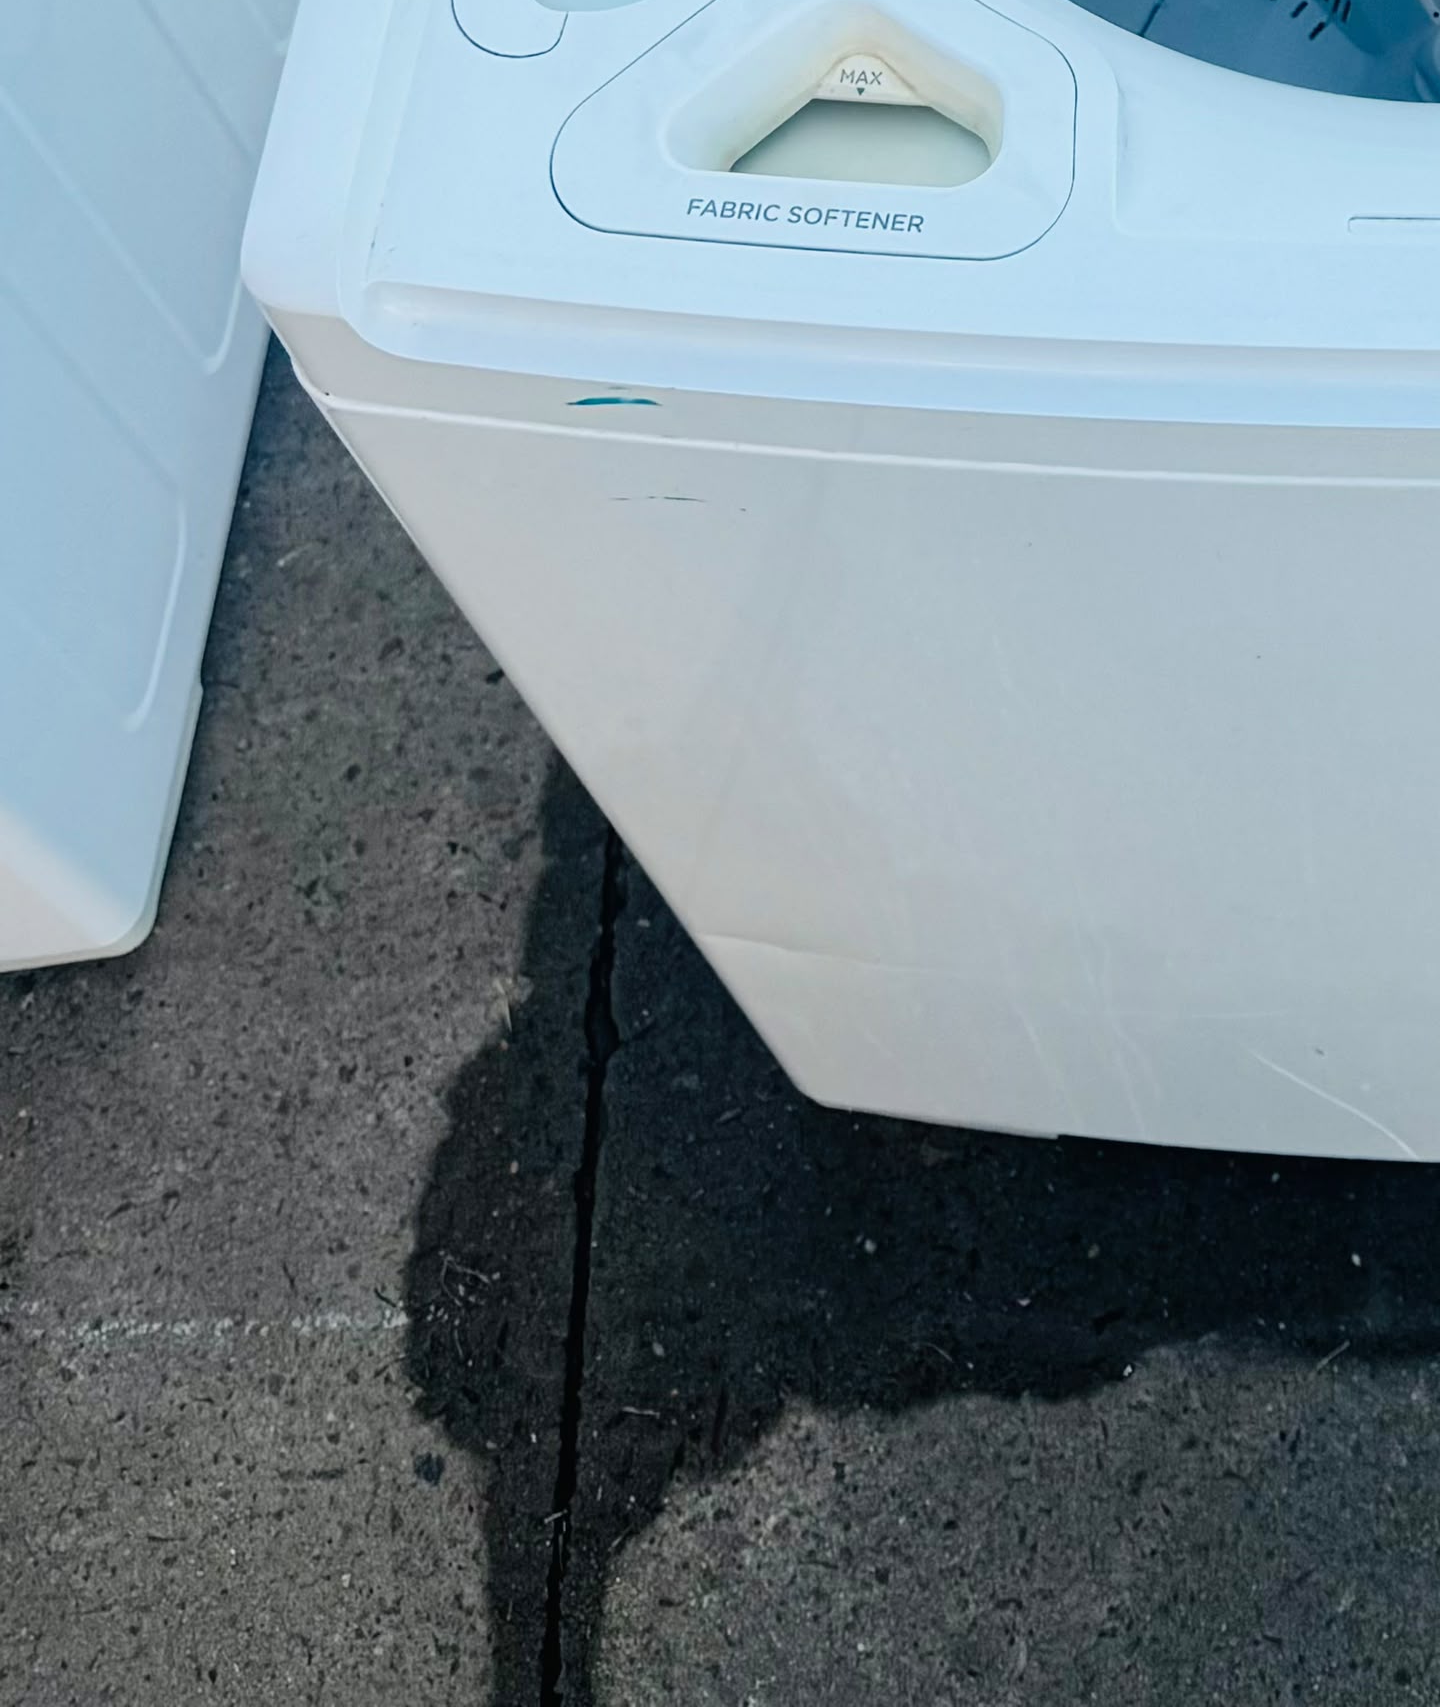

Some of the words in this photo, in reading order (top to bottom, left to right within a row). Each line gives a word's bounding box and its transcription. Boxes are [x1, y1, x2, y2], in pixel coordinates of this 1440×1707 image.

[839, 68, 883, 86] MAX
[686, 198, 781, 222] FABRIC
[787, 205, 925, 233] SOFTENER
